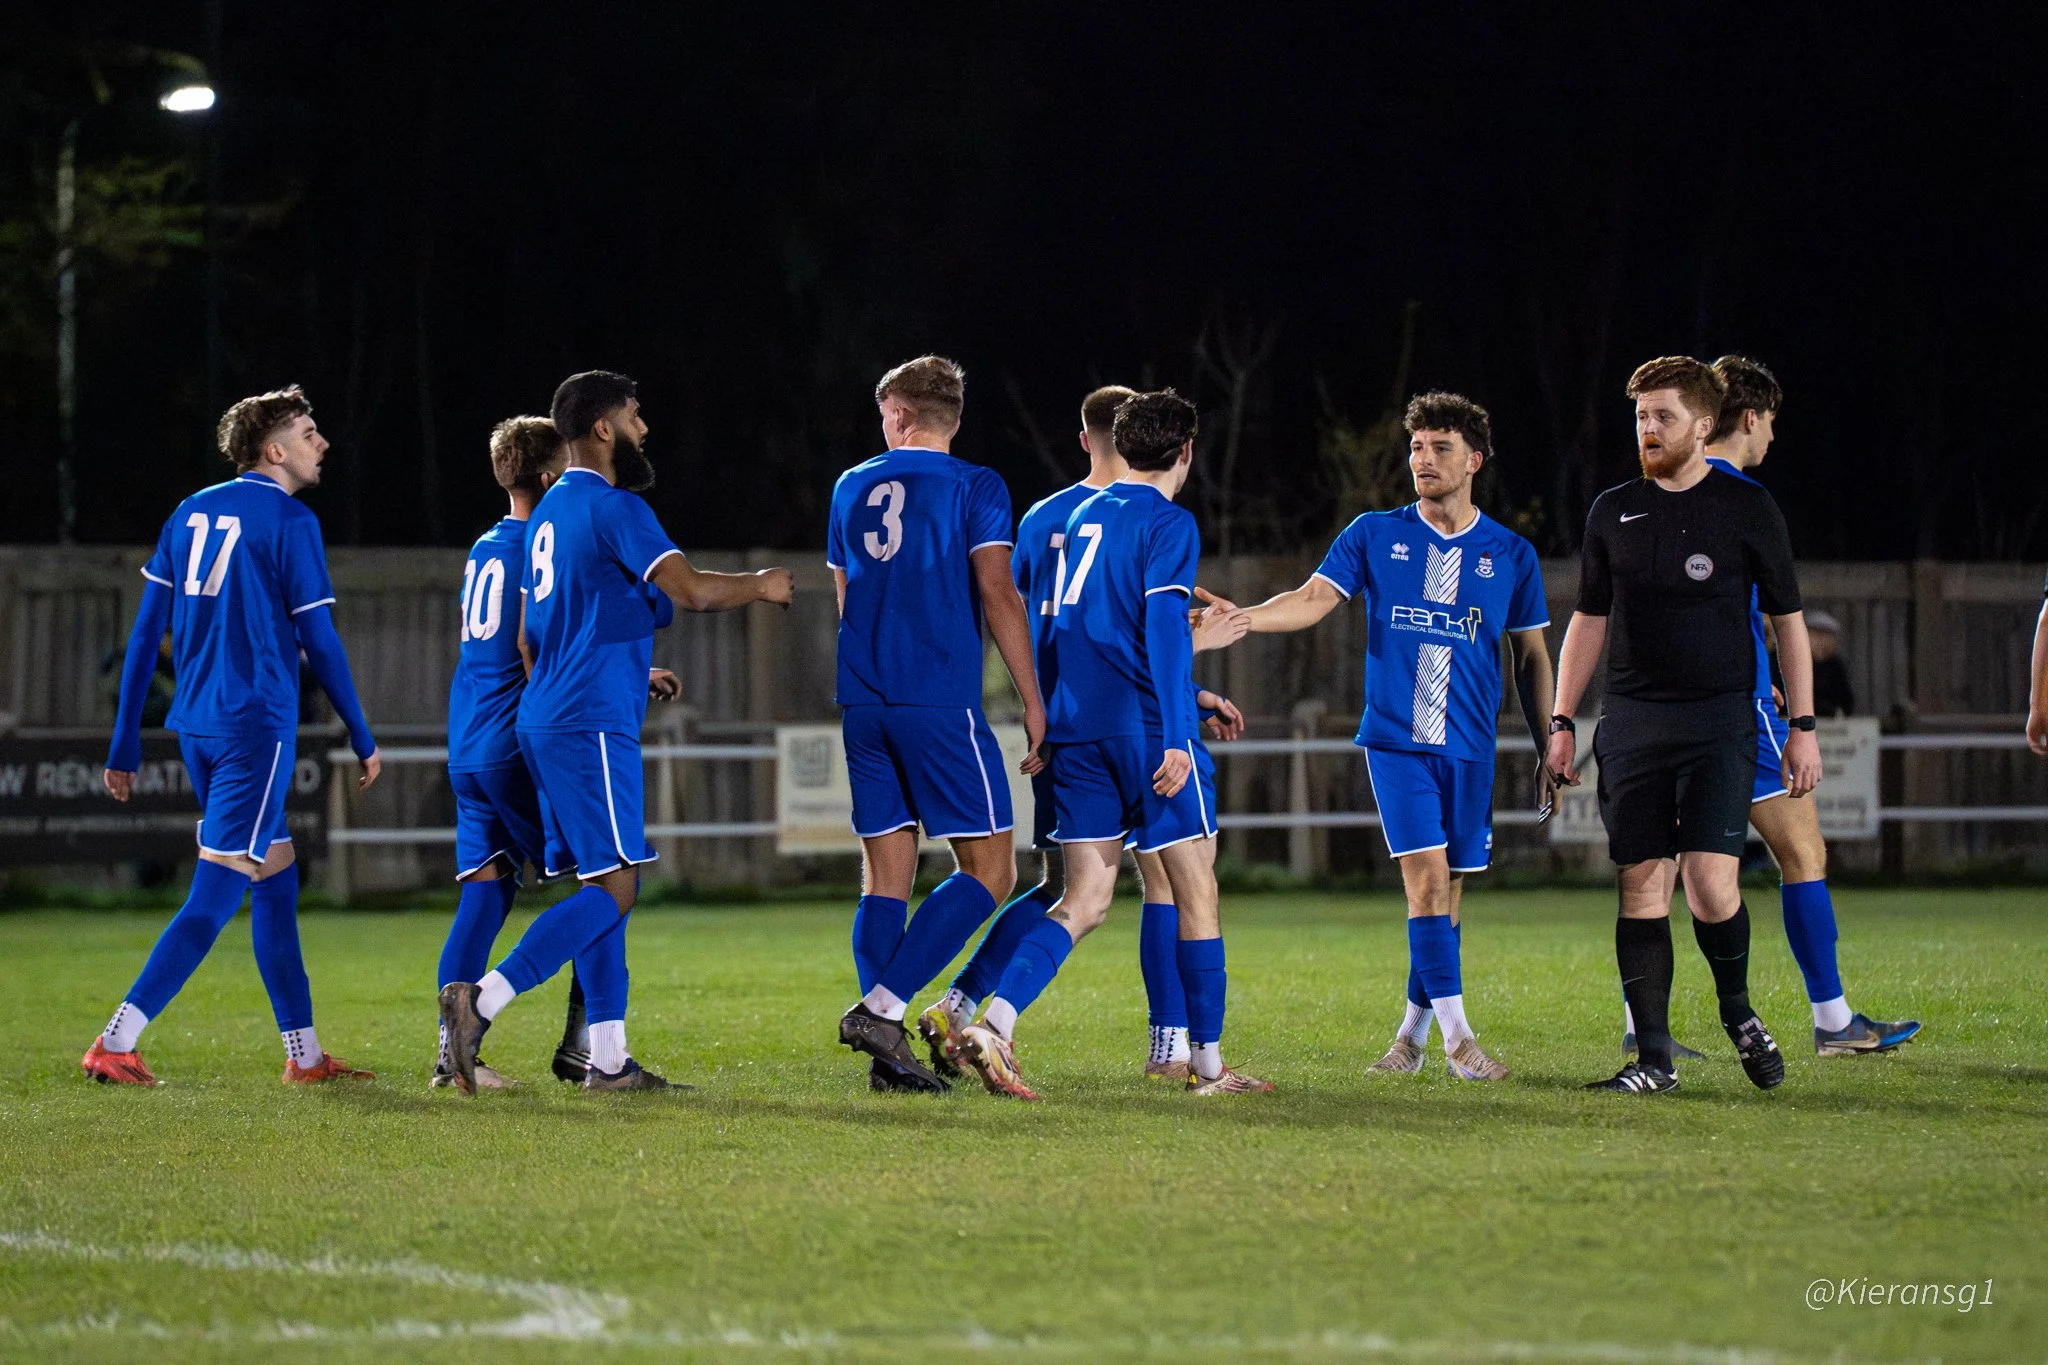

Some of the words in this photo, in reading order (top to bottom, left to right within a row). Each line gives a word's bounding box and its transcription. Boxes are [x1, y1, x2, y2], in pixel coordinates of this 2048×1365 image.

[184, 512, 242, 596] 17
[531, 520, 555, 603] 8
[863, 480, 906, 562] 3
[461, 557, 505, 642] 10
[1690, 563, 1708, 571] NFA
[1391, 623, 1427, 633] ELECTRICAL
[1428, 627, 1467, 640] DISTRIBUTORS
